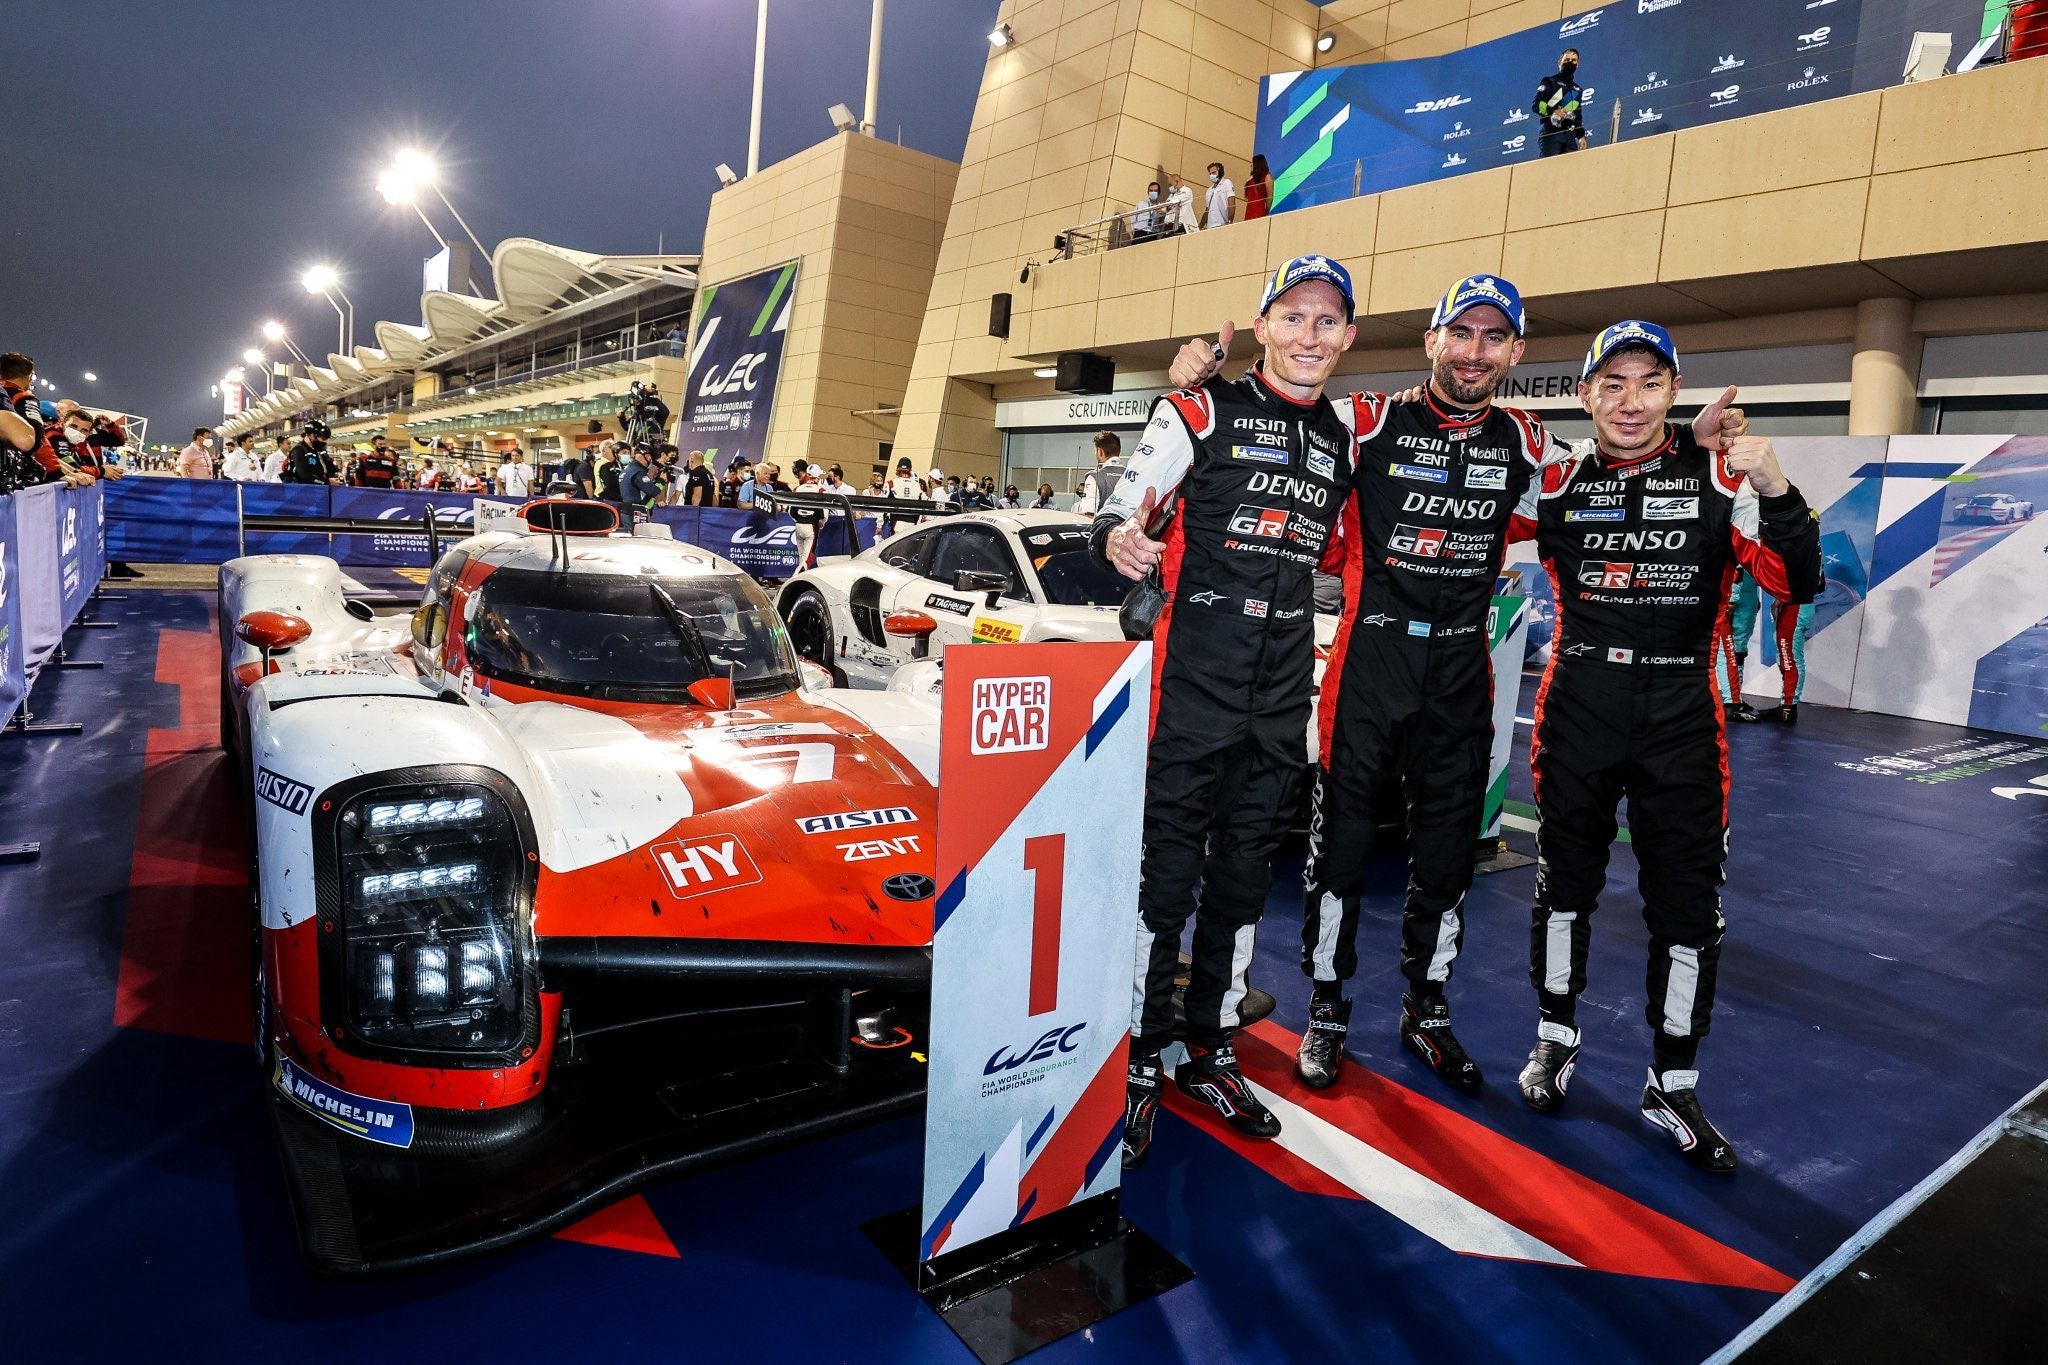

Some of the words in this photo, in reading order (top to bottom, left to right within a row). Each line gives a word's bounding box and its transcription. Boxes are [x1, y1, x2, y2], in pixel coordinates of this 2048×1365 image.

[1560, 10, 1604, 32] WEC
[1633, 79, 1669, 94] ROLEX
[1786, 74, 1830, 91] ROLEX
[1443, 127, 1472, 141] ROLEX
[1456, 287, 1512, 307] MICHELIN
[1603, 331, 1662, 350] MICHELIN
[698, 352, 768, 397] WEC
[694, 404, 705, 414] FIA
[704, 402, 723, 413] WORLD
[722, 400, 754, 412] ENDURANCE
[693, 413, 731, 424] CHAMPIONSHIP
[1233, 418, 1287, 433] AISIN
[1254, 433, 1289, 448] ZENT
[1248, 450, 1285, 461] MICHELIN
[1413, 452, 1450, 467] ZENT
[1468, 446, 1498, 460] Mobil
[1405, 469, 1443, 480] MICHELIN
[1468, 468, 1505, 480] WEC
[1246, 470, 1328, 508] DENSO
[1571, 480, 1626, 493] AISIN
[1645, 477, 1684, 491] Mobil
[754, 495, 773, 514] BOSS
[1401, 491, 1498, 521] DENSO
[1588, 495, 1626, 507] ZENT
[1646, 499, 1696, 511] WEC
[480, 503, 507, 520] RACING
[1581, 511, 1620, 519] MICHELIN
[1230, 516, 1284, 539] GR
[1296, 513, 1327, 533] TOYOTA
[1451, 532, 1496, 542] TOYOTA
[1583, 530, 1687, 552] DENSO
[743, 548, 768, 556] WORLD
[1223, 540, 1280, 556] RACING
[1389, 534, 1441, 557] GR
[1445, 541, 1489, 551] GAZOO
[729, 553, 782, 561] CHAMPIONSHIP
[1441, 550, 1487, 562] Racing
[1384, 556, 1439, 575] RACING
[1636, 562, 1699, 573] TOYOTA
[1579, 571, 1629, 589] GR
[1635, 571, 1693, 581] GAZOO
[1633, 579, 1690, 590] Racing
[1579, 592, 1635, 605] RACING
[1636, 595, 1700, 606] HYBRID
[979, 622, 1017, 642] DHL
[1454, 624, 1477, 635] LOPEZ
[1650, 656, 1695, 665] KOBAYASHI
[461, 675, 470, 696] E
[976, 681, 1046, 709] HYPER
[724, 723, 795, 734] WEC
[975, 706, 1046, 749] CAR
[258, 768, 312, 814] AISIN
[805, 808, 912, 834] AISIN
[835, 835, 922, 862] ZENT
[660, 840, 741, 888] HY
[1023, 833, 1066, 1018] 1
[982, 1022, 1088, 1076] WEC
[981, 1080, 997, 1090] FIA
[998, 1071, 1029, 1087] WORLD
[1029, 1056, 1079, 1077] ENDURANCE
[981, 1074, 1046, 1099] CHAMPIONSHIP
[294, 1079, 395, 1129] MICHELIN
